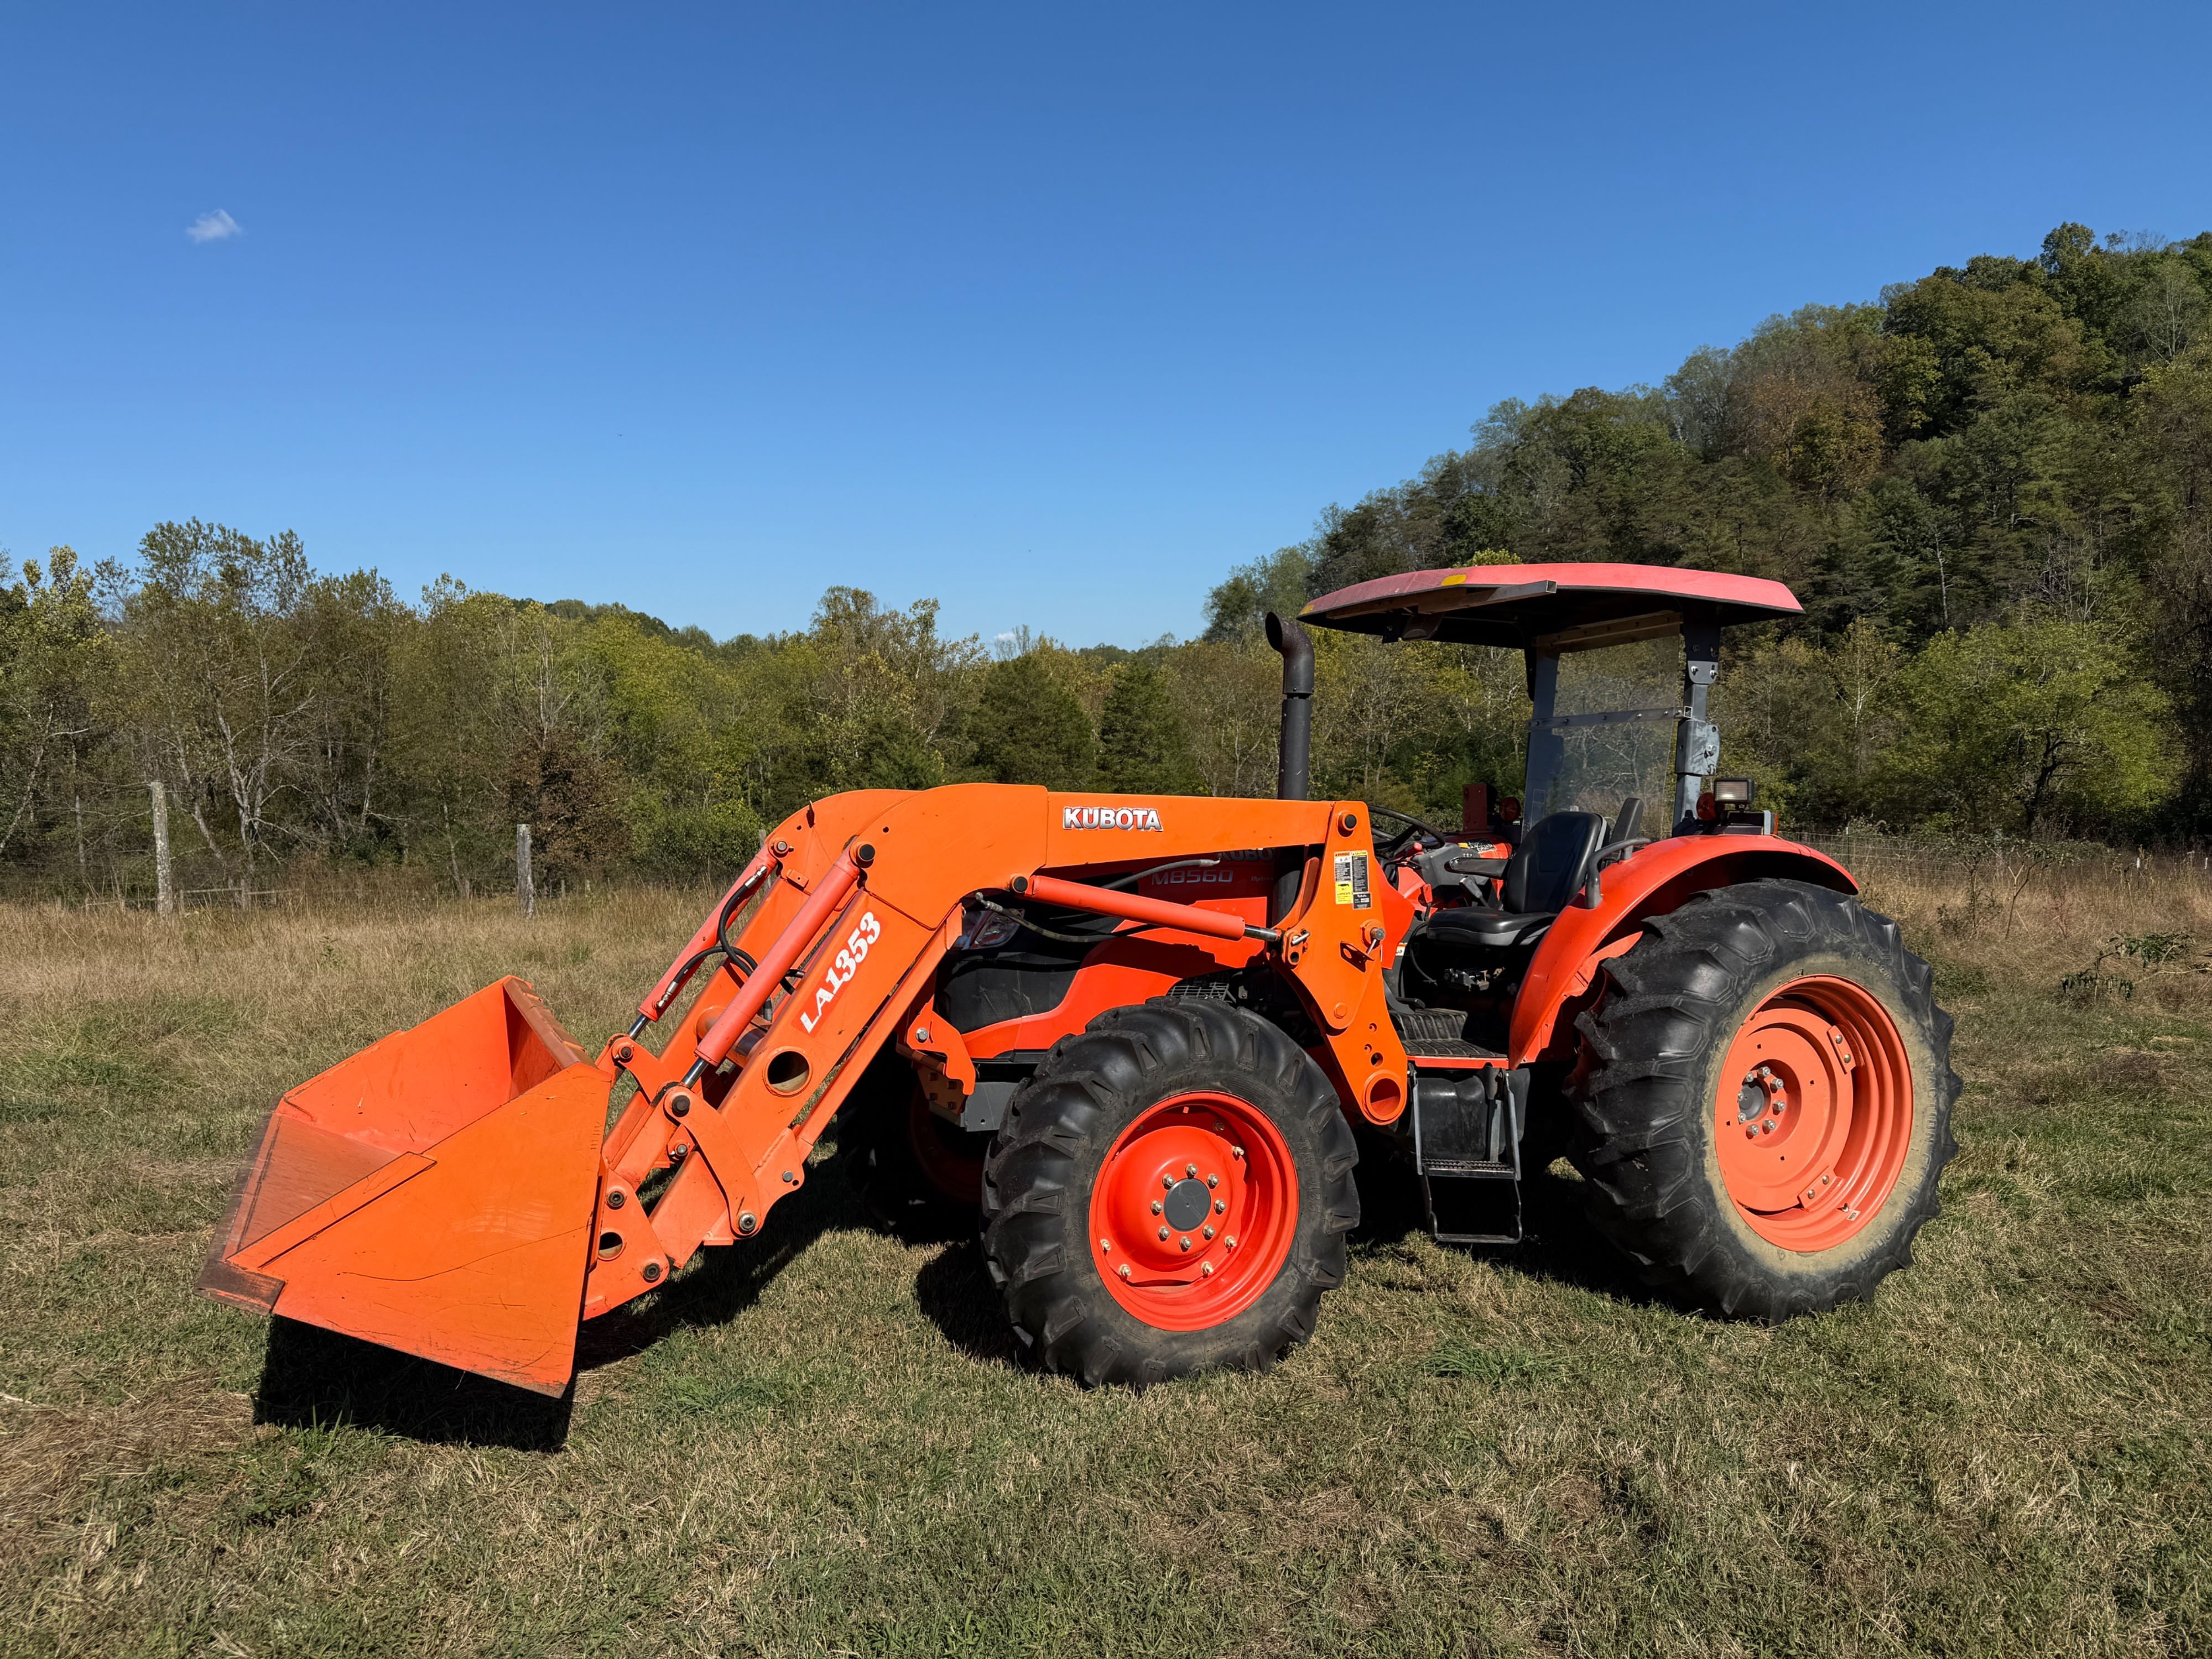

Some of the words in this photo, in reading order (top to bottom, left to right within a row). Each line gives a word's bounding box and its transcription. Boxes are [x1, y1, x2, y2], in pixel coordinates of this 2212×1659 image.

[1064, 807, 1162, 830] KUBOTA
[1151, 869, 1233, 885] M8560
[800, 912, 881, 1033] LA1353
